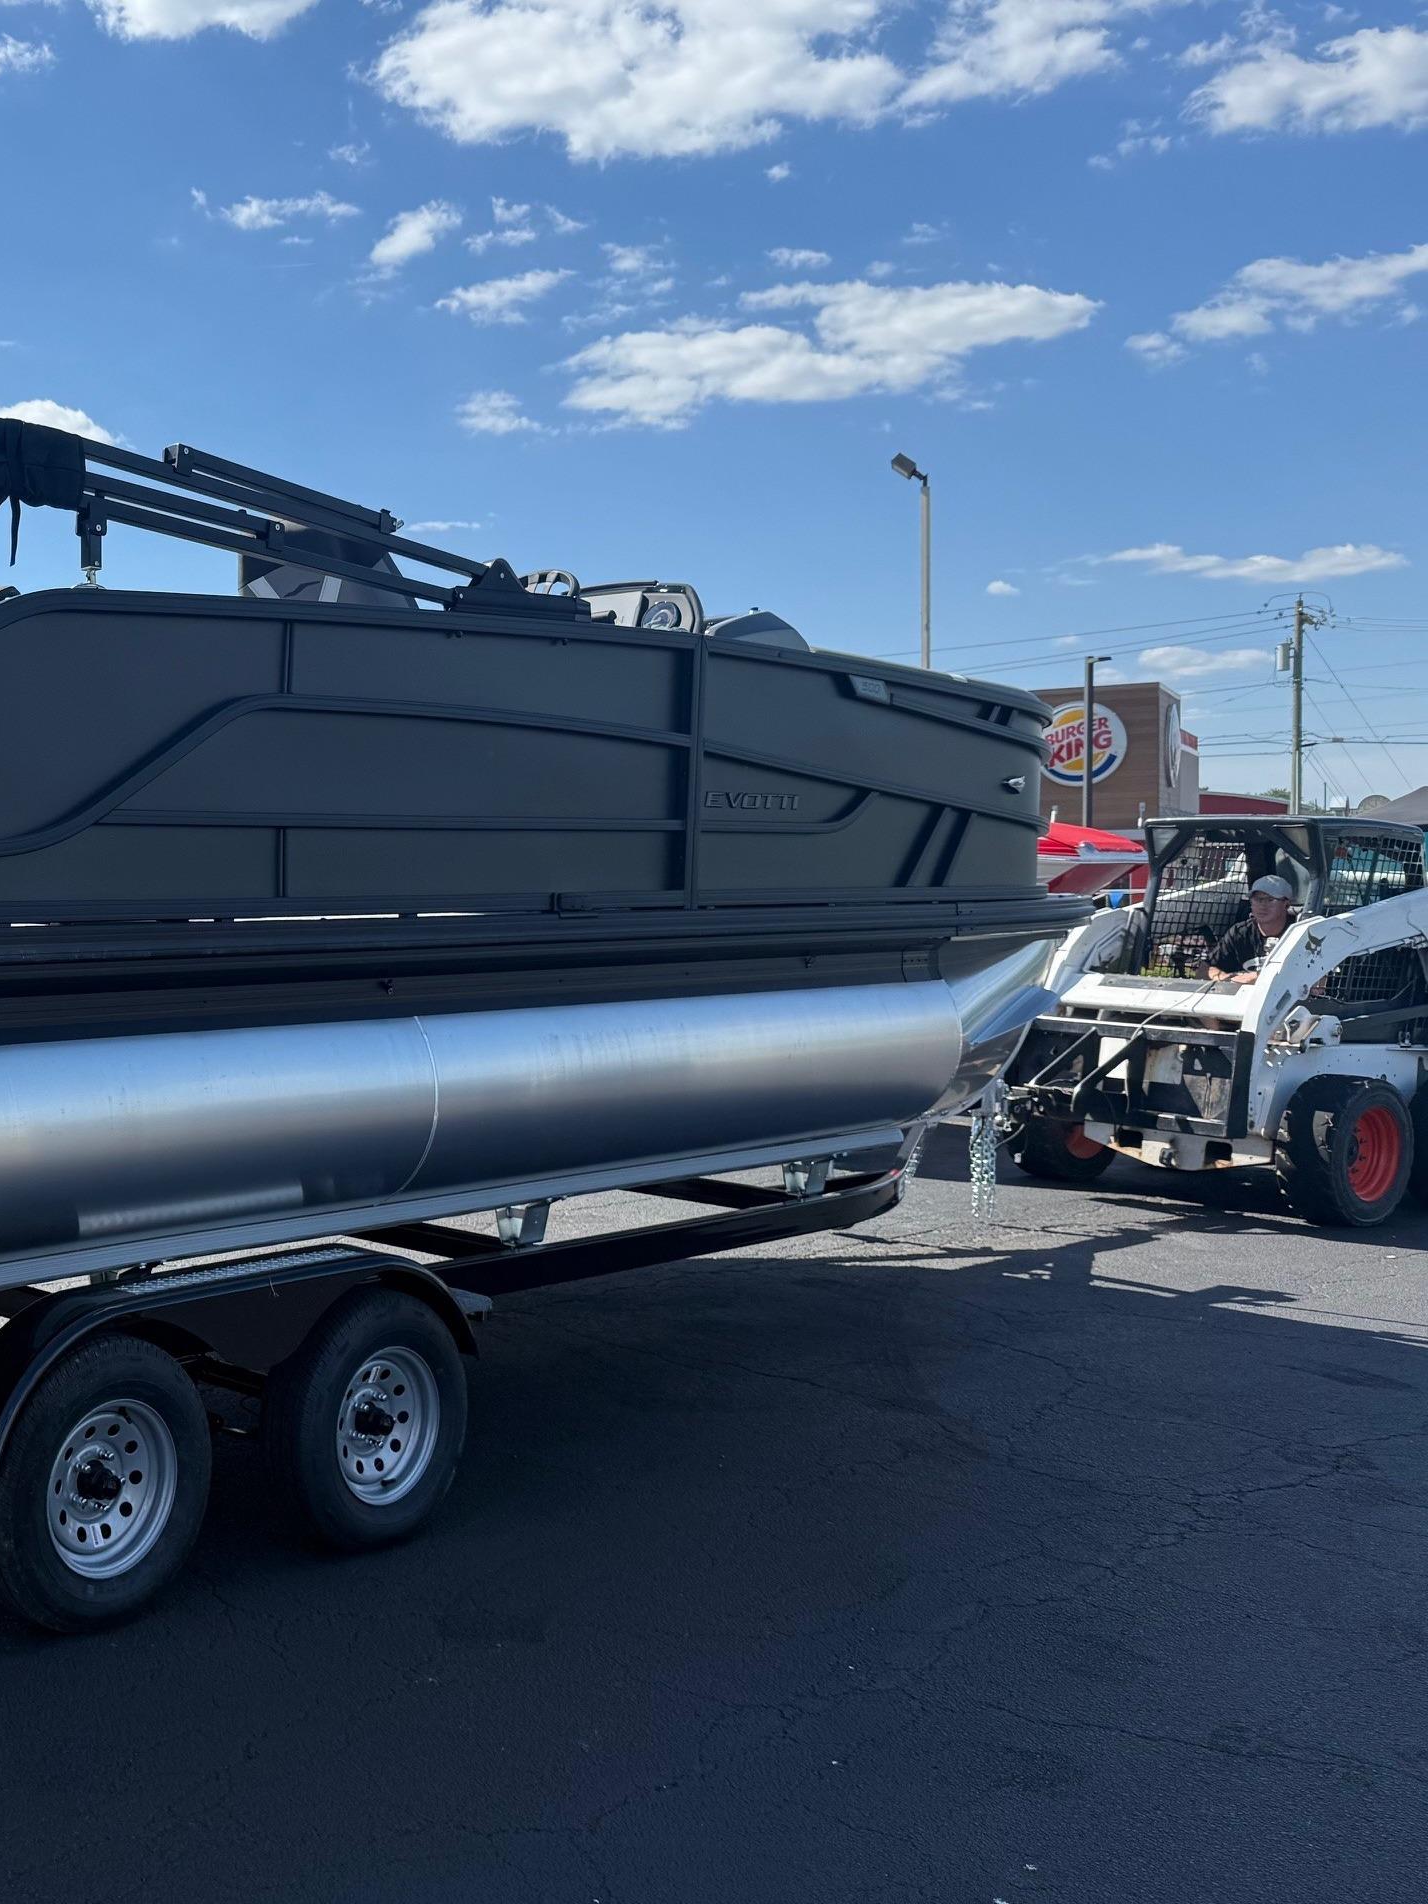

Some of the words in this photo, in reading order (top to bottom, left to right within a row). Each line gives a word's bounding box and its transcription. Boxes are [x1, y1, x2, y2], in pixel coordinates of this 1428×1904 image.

[1045, 717, 1109, 745] BURGER
[1049, 730, 1112, 768] KING
[704, 791, 799, 810] EVOTTI
